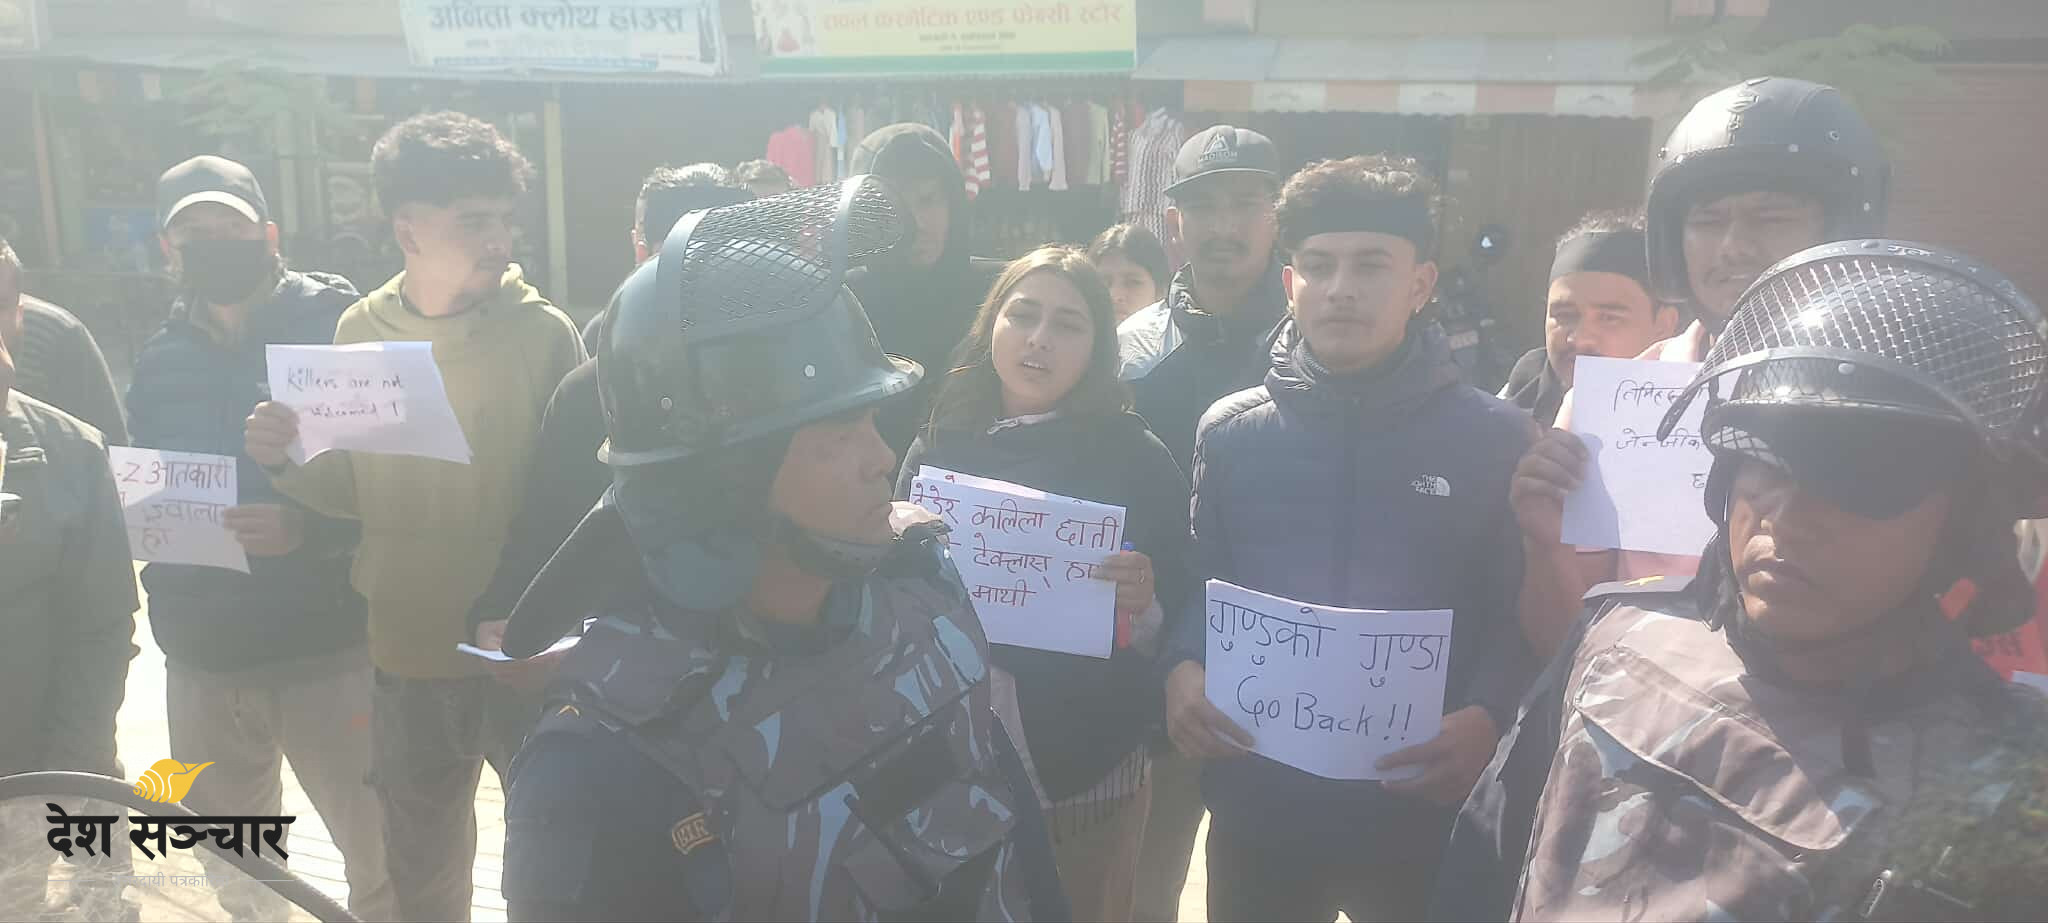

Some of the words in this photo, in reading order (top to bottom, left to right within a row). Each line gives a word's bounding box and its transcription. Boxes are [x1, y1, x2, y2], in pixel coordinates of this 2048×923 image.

[608, 6, 686, 32] हाउस
[349, 376, 370, 389] are
[382, 374, 404, 389] not
[970, 498, 1052, 535] कलिला
[1055, 516, 1120, 552] छाती
[1359, 632, 1449, 688] गुण्डा
[1236, 674, 1281, 728] Go
[1293, 691, 1370, 737] Back
